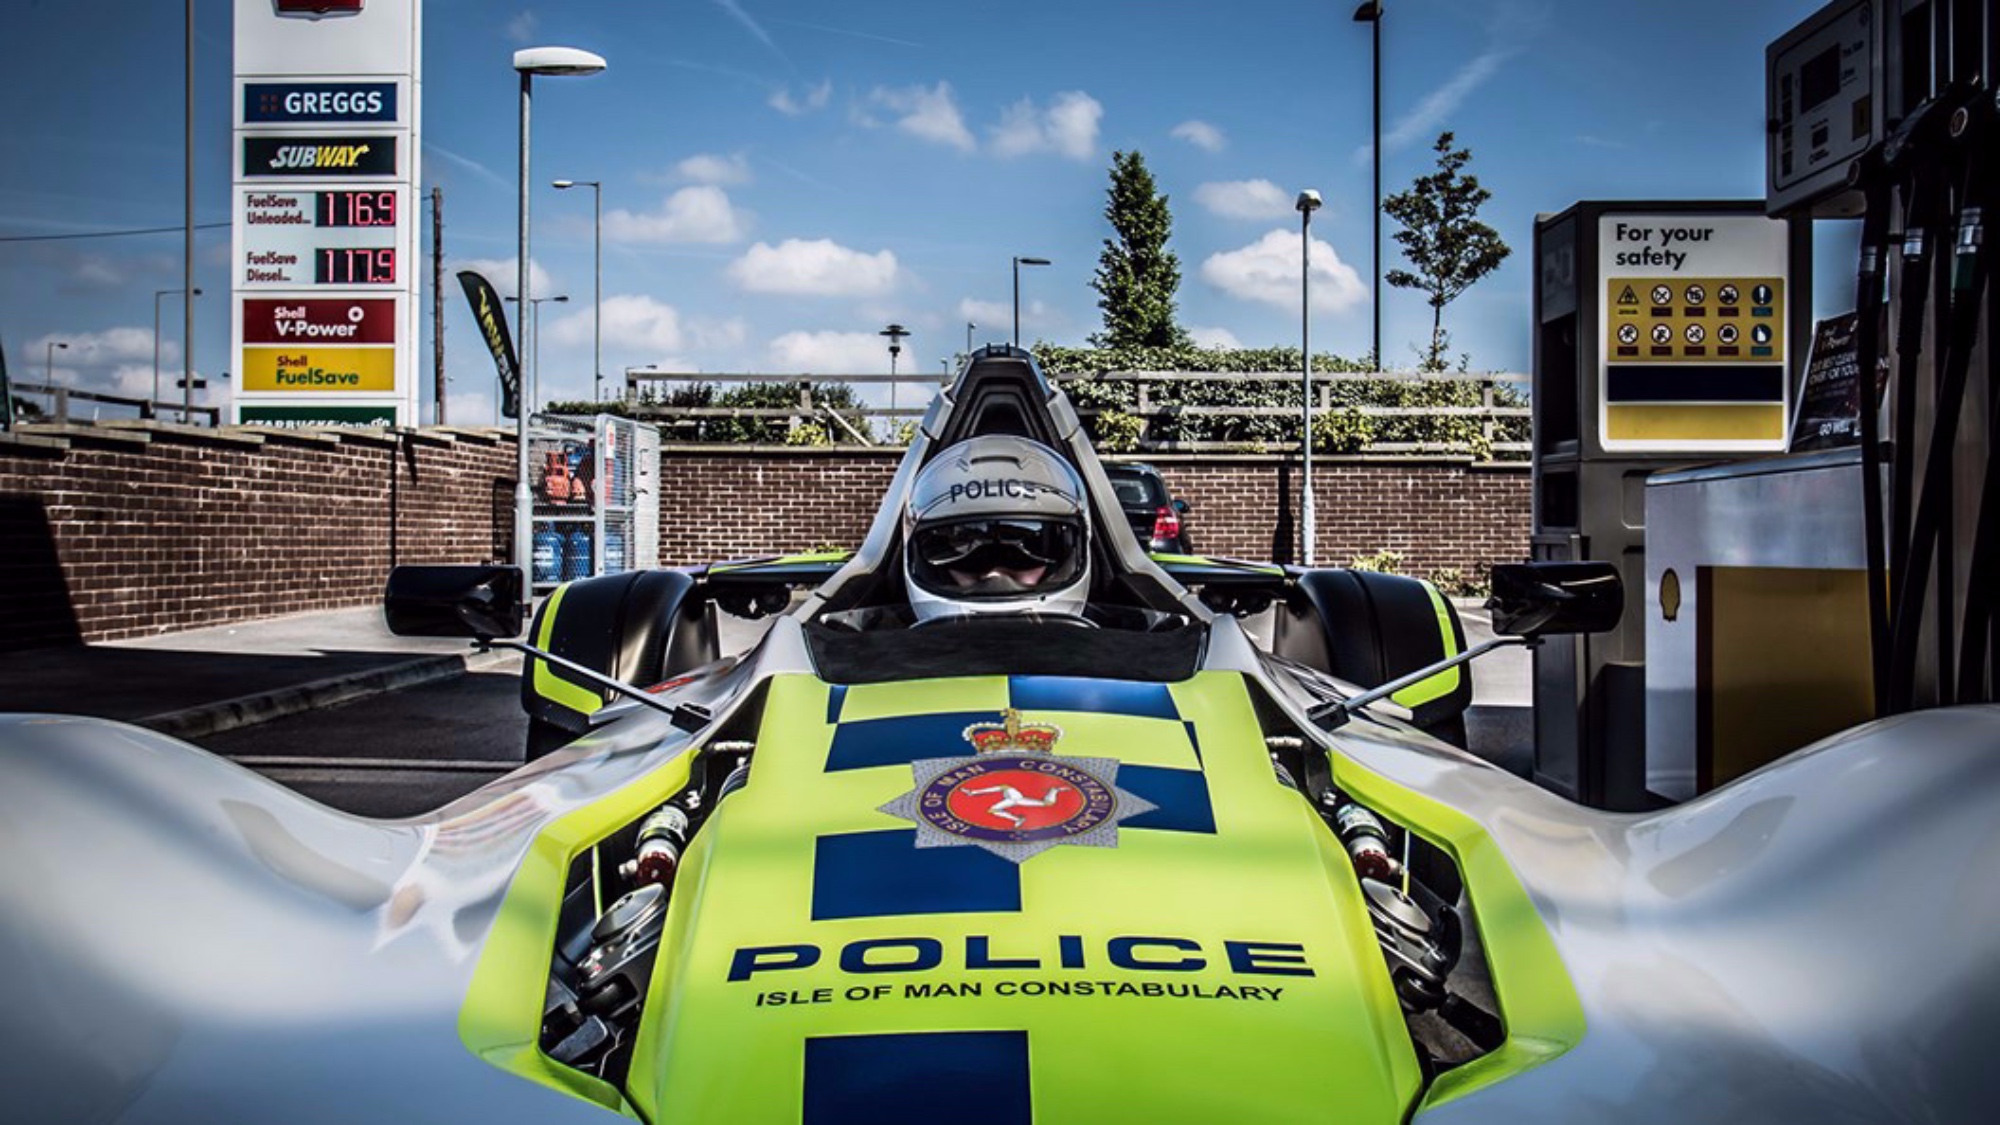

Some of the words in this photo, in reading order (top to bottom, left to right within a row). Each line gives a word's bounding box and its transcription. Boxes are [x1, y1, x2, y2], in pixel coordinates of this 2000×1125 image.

[285, 91, 382, 114] GREGGS
[269, 144, 370, 169] SUBWAY
[247, 194, 297, 207] FuelSave
[326, 192, 395, 226] 116.9
[1616, 224, 1652, 241] For
[1661, 228, 1713, 246] your
[247, 251, 297, 265] FuelSave
[325, 249, 395, 283] 117.9
[1616, 247, 1686, 270] safety
[274, 306, 306, 319] Shell
[275, 320, 358, 337] V-Power
[276, 355, 307, 367] Shell
[276, 367, 360, 385] FuelSave
[950, 478, 1037, 503] POLICE
[937, 764, 985, 787] MAN
[924, 791, 943, 807] OF
[1019, 760, 1109, 835] CONSTABULARY
[928, 810, 970, 833] ISLE
[727, 935, 1316, 981] POLICE
[756, 988, 834, 1006] ISLE
[845, 983, 893, 1001] OF
[904, 981, 983, 999] MAN
[995, 980, 1285, 1002] CONSTABULARY
